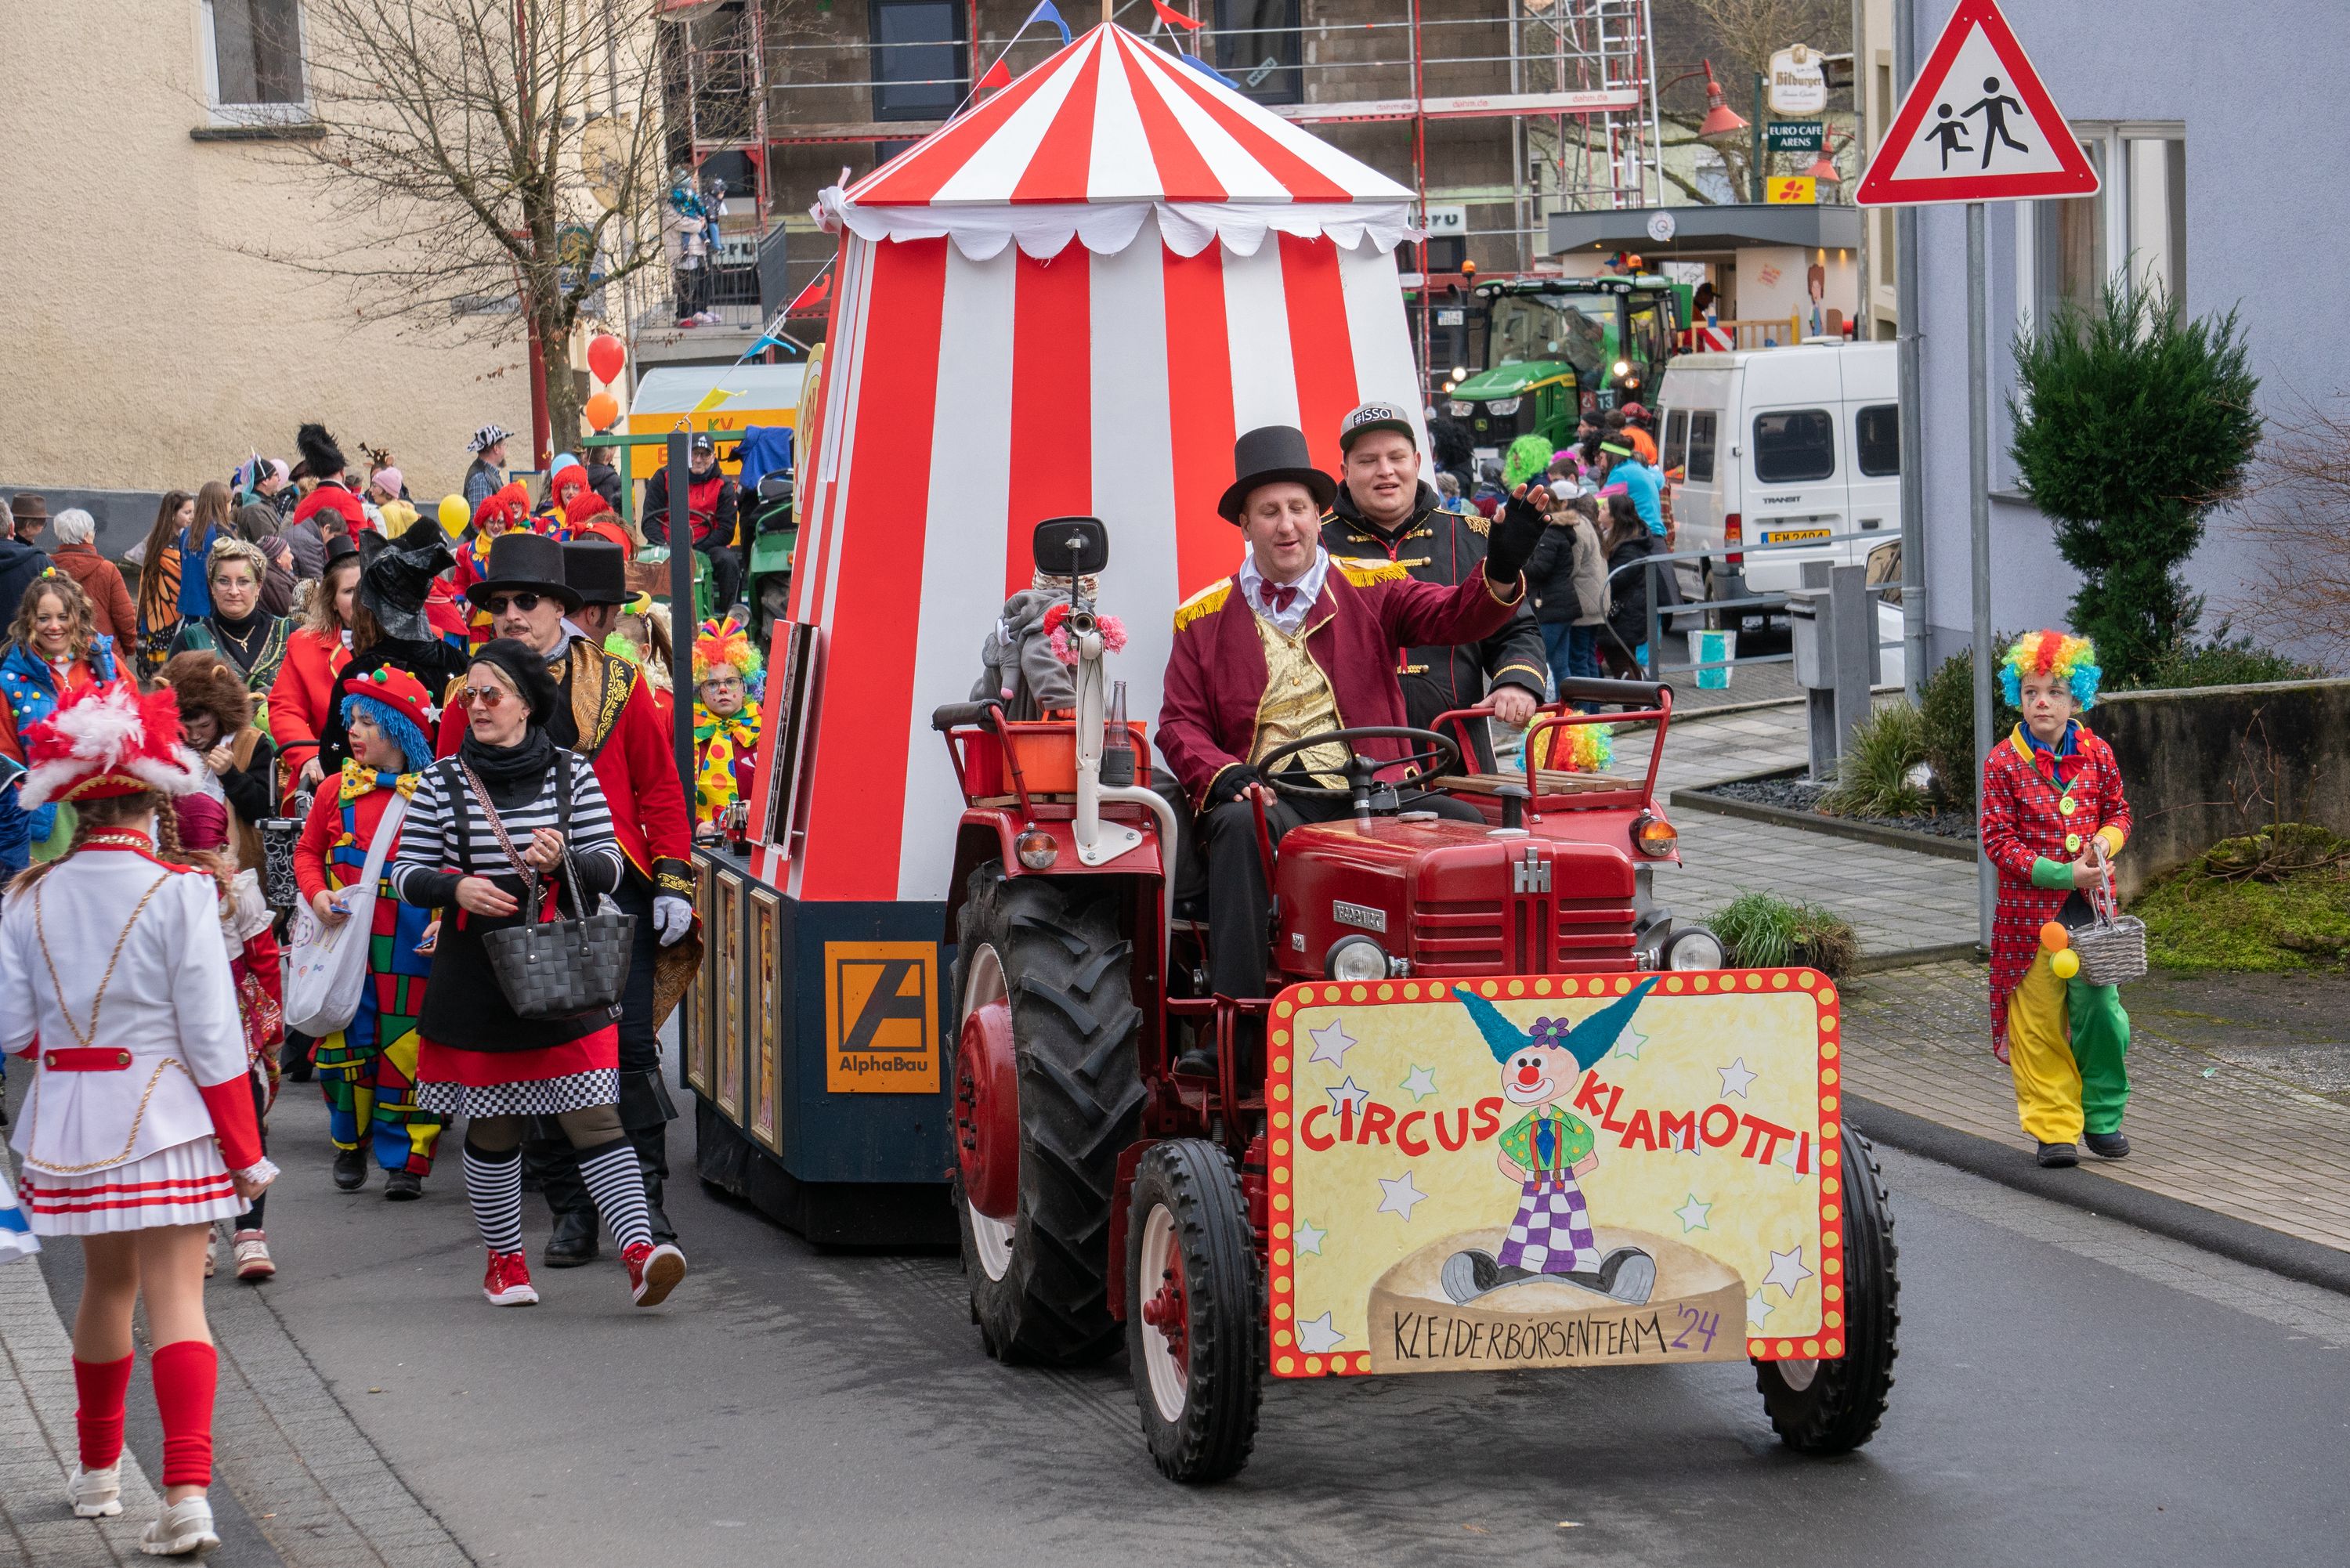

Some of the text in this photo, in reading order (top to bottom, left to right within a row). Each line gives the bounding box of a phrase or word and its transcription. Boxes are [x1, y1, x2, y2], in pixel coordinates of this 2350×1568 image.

[1770, 126, 1797, 135] EURO
[1780, 138, 1812, 146] ARENS
[1598, 396, 1614, 409] 13
[1354, 408, 1390, 425] #ISSO
[839, 1055, 927, 1075] AlphaBau
[1300, 1069, 1810, 1175] CIRCUS KLAMOTTI
[1394, 1311, 1668, 1360] KLEIDERBÖRSENTEAM
